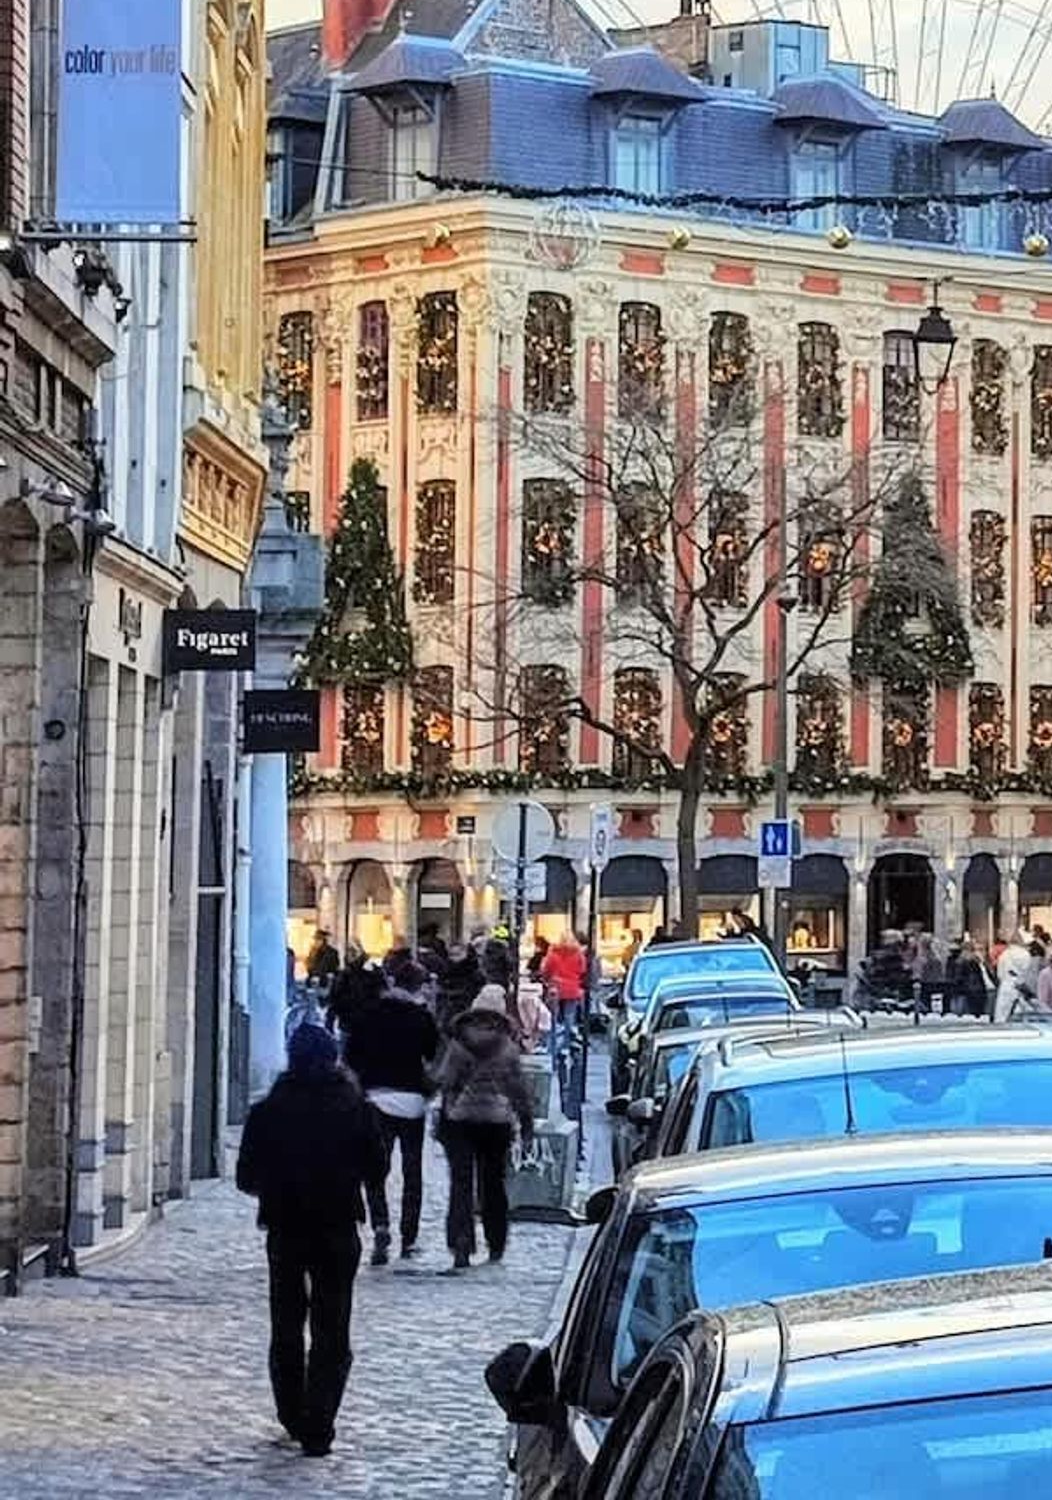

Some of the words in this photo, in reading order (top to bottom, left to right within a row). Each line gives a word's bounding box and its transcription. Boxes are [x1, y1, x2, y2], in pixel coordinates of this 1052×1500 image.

[65, 44, 105, 73] color
[110, 49, 144, 77] your
[149, 44, 176, 74] life
[177, 628, 249, 653] Figaret
